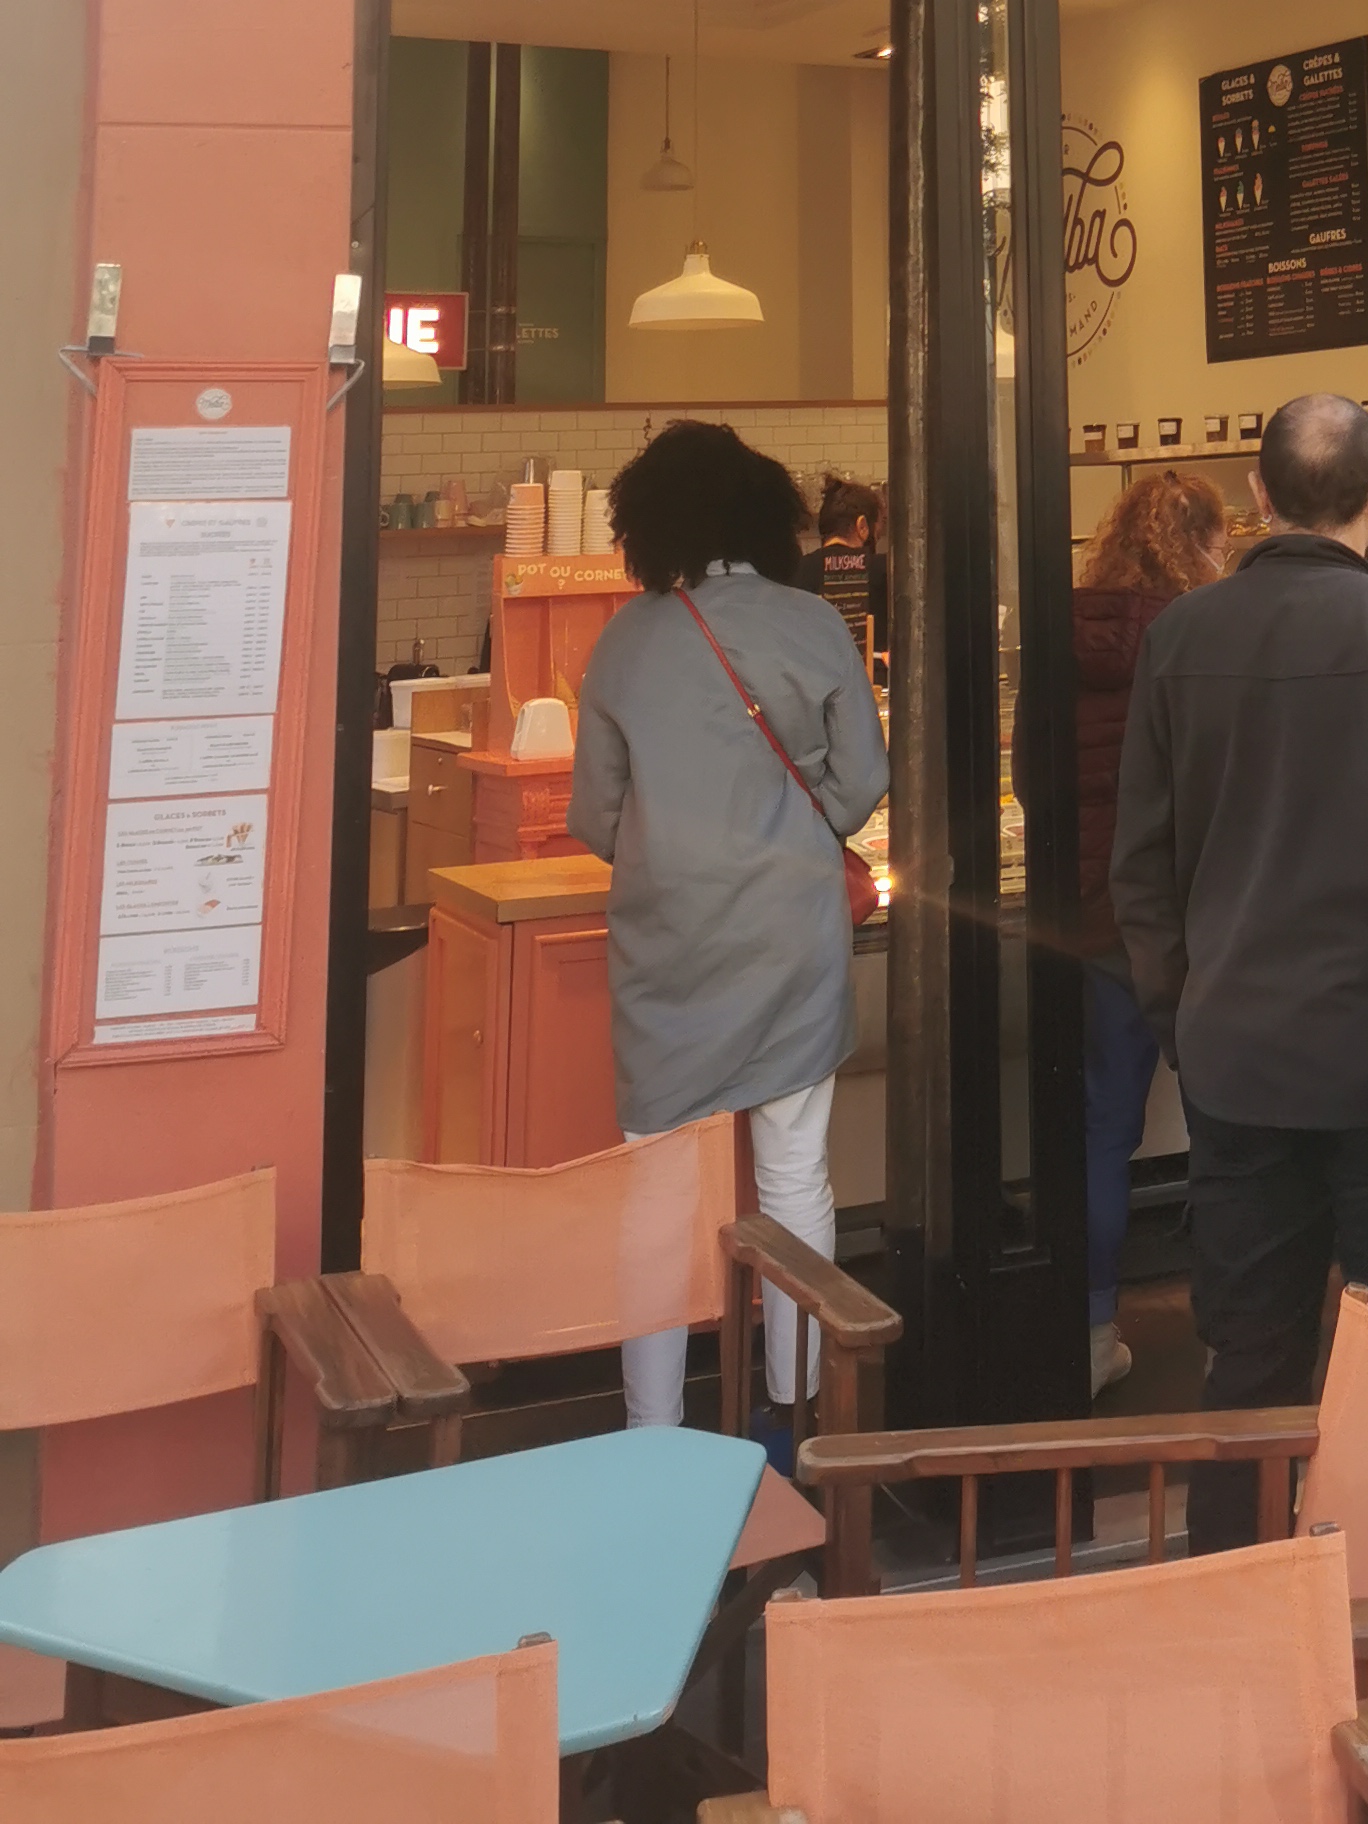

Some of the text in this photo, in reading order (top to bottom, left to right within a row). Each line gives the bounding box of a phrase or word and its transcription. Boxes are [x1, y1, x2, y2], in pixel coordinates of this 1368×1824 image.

[1304, 67, 1343, 86] GALETTES
[1221, 89, 1254, 106] SORBETS
[1310, 228, 1347, 244] GAUFRES
[1268, 257, 1307, 273] BOISSONS
[518, 563, 547, 576] POT
[550, 566, 571, 577] OU
